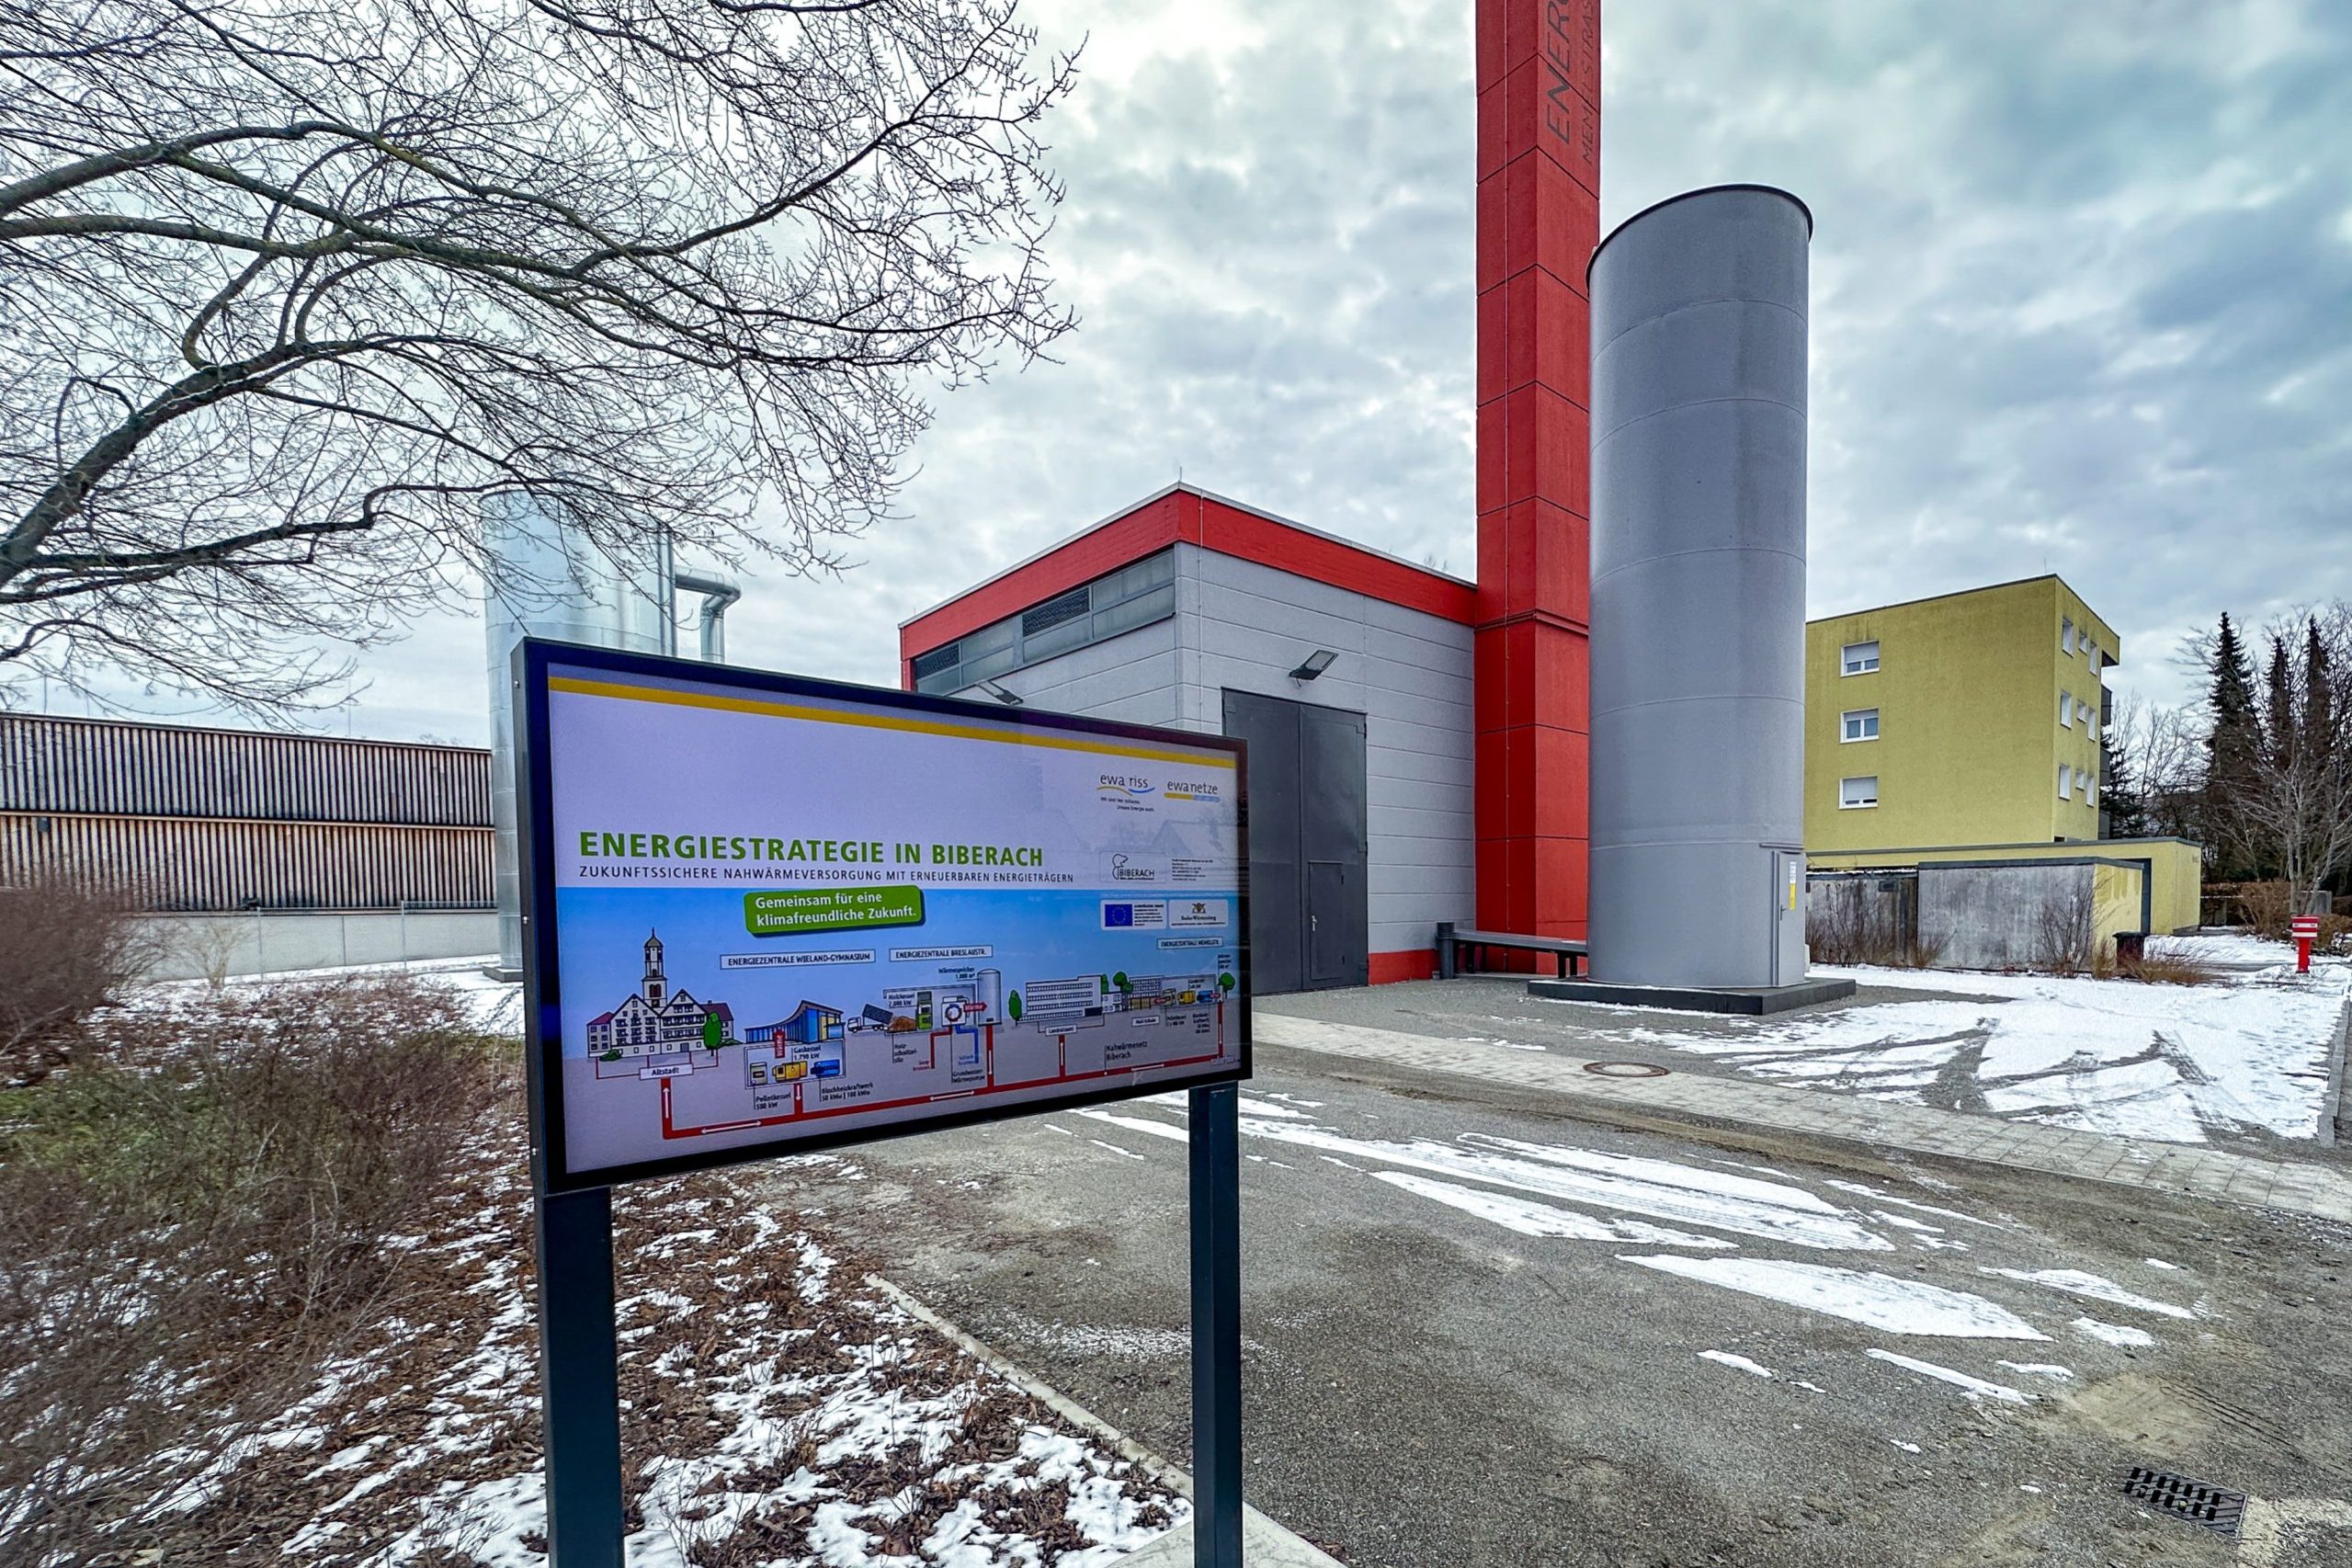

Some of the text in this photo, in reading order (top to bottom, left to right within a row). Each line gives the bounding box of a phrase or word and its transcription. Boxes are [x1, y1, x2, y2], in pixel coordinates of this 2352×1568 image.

[1547, 0, 1570, 144] ENER
[1100, 774, 1149, 789] ewa riss
[580, 831, 1043, 867] ENERGIESTRATEGIE IN BIBERACH
[579, 866, 1074, 882] ZUKUNFTSSICHERE NAHWÄRMEVERSORGUNG MIT ERNEUERBAREN ENERGIETRÄGERN
[1119, 869, 1155, 877] BIBERACH
[756, 892, 882, 909] Gemeinsam für eine
[756, 905, 917, 926] klimafreundliche Zukunft.
[728, 952, 870, 966] ENERGIEZENTRALE WIELAND-GYMNASIUM
[895, 949, 950, 959] ENERGIEZENTRALE
[652, 1066, 680, 1076] Altstadt
